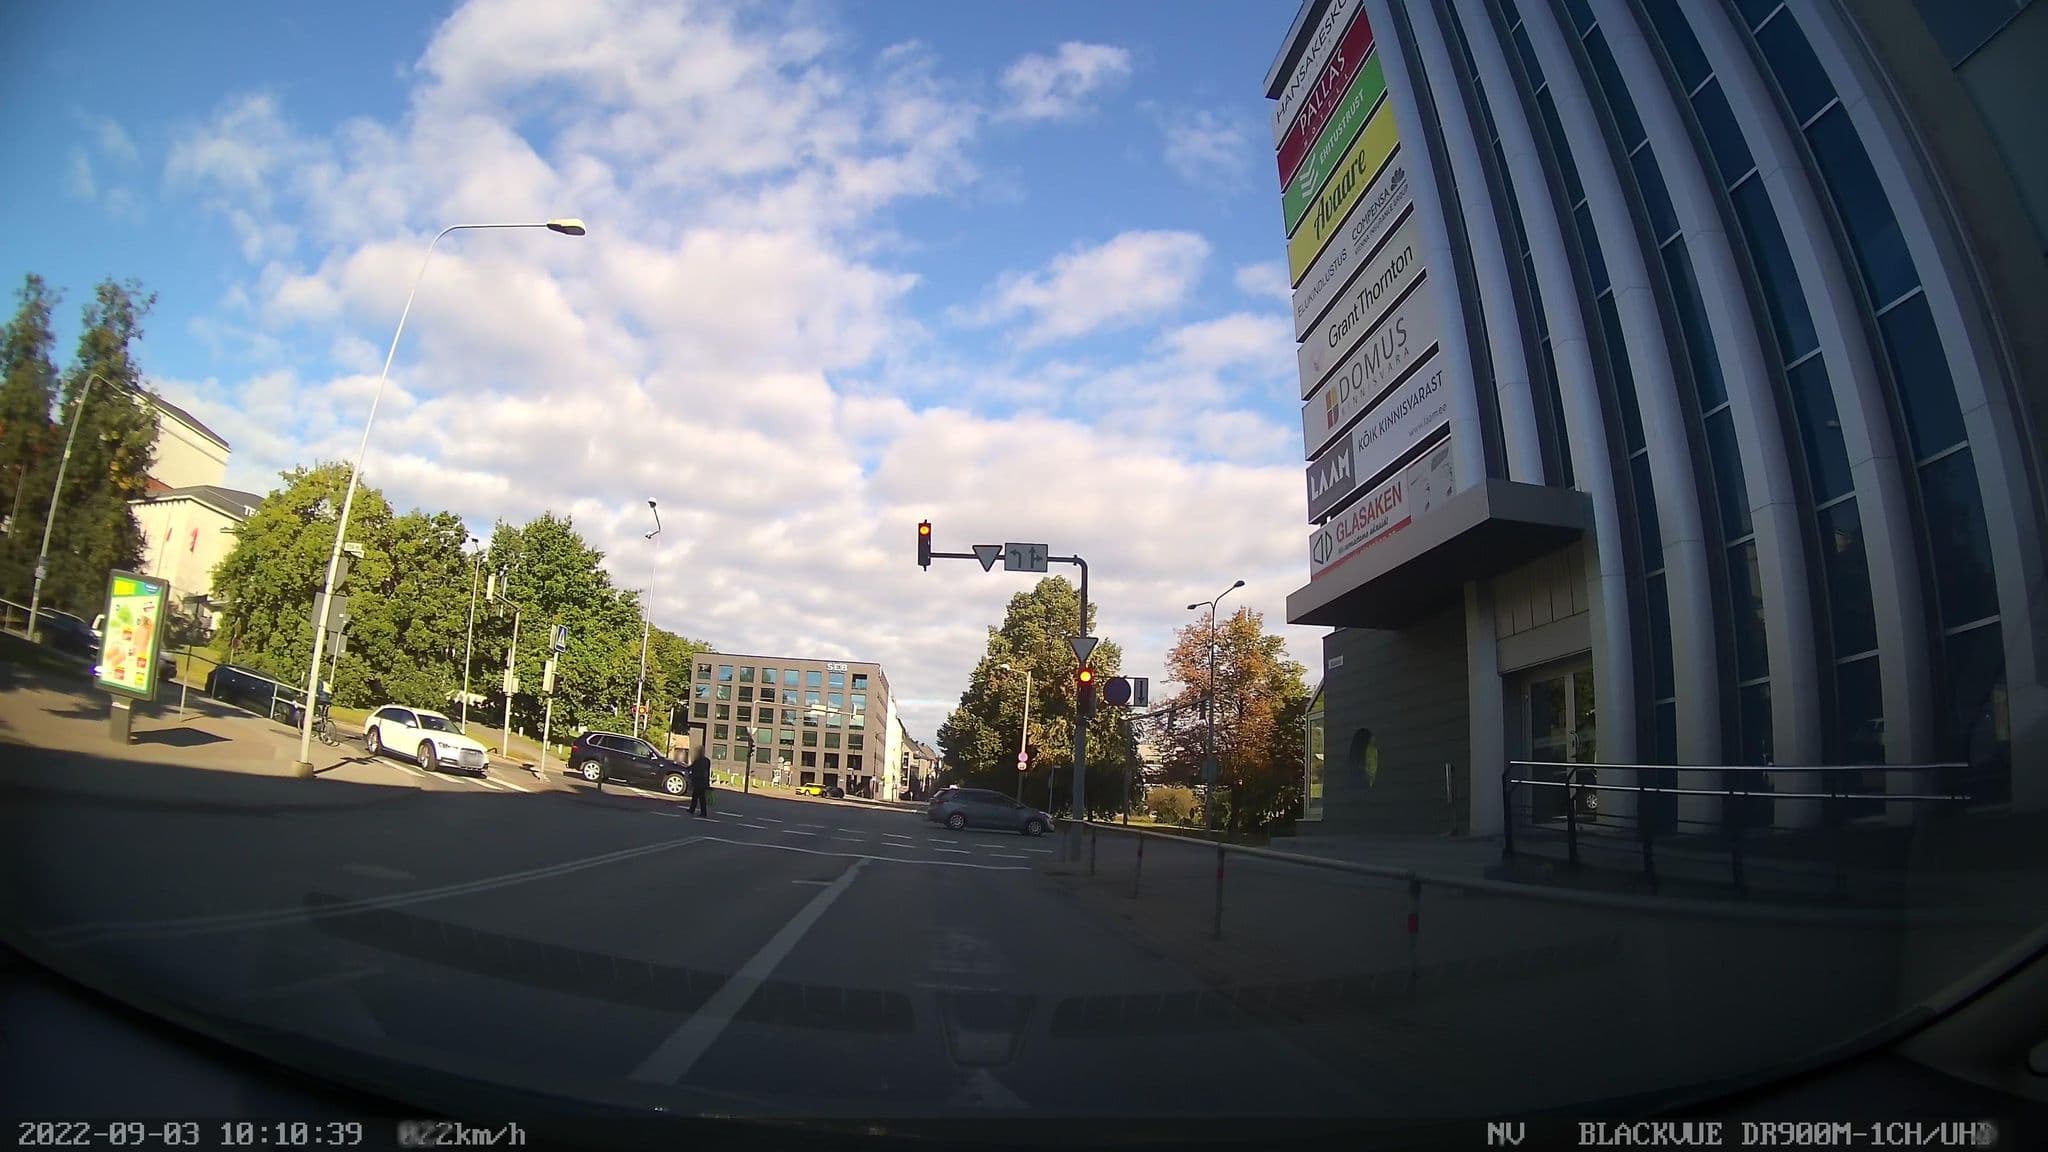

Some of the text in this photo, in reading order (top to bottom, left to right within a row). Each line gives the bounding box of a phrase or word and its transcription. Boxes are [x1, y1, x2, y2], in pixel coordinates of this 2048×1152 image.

[1300, 49, 1345, 136] PALLAS
[1319, 89, 1364, 165] EHITUSTRUST
[1313, 149, 1367, 241] Avaare
[1352, 188, 1390, 241] COMPENSA
[1328, 245, 1413, 349] Grant Thornton
[1339, 317, 1407, 404] DOMUS
[1357, 370, 1443, 453] KÕIK KINNISVARAST
[1336, 481, 1402, 543] GLASAKEN
[826, 663, 848, 672] SEB
